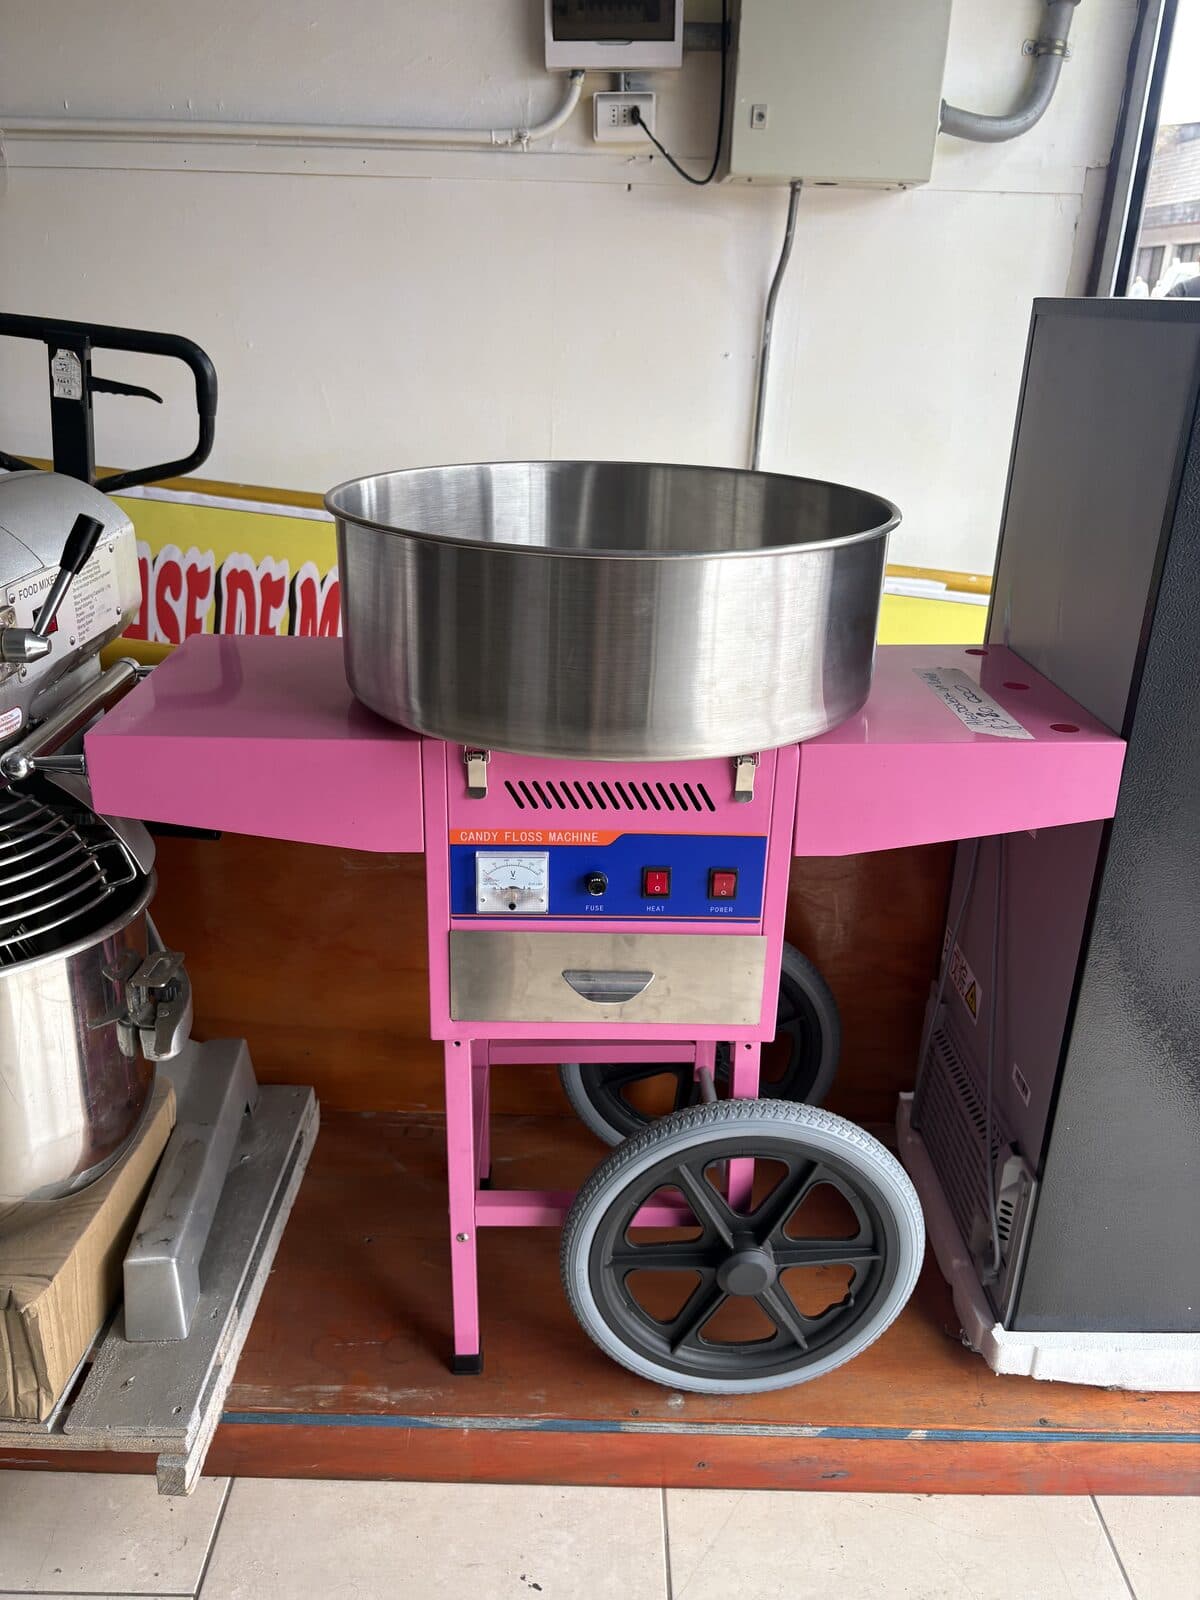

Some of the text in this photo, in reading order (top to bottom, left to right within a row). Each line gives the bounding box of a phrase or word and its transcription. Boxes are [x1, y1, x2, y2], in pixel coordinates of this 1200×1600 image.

[18, 583, 38, 600] FOOD
[460, 831, 599, 843] CANDY FLOSS MACHINE
